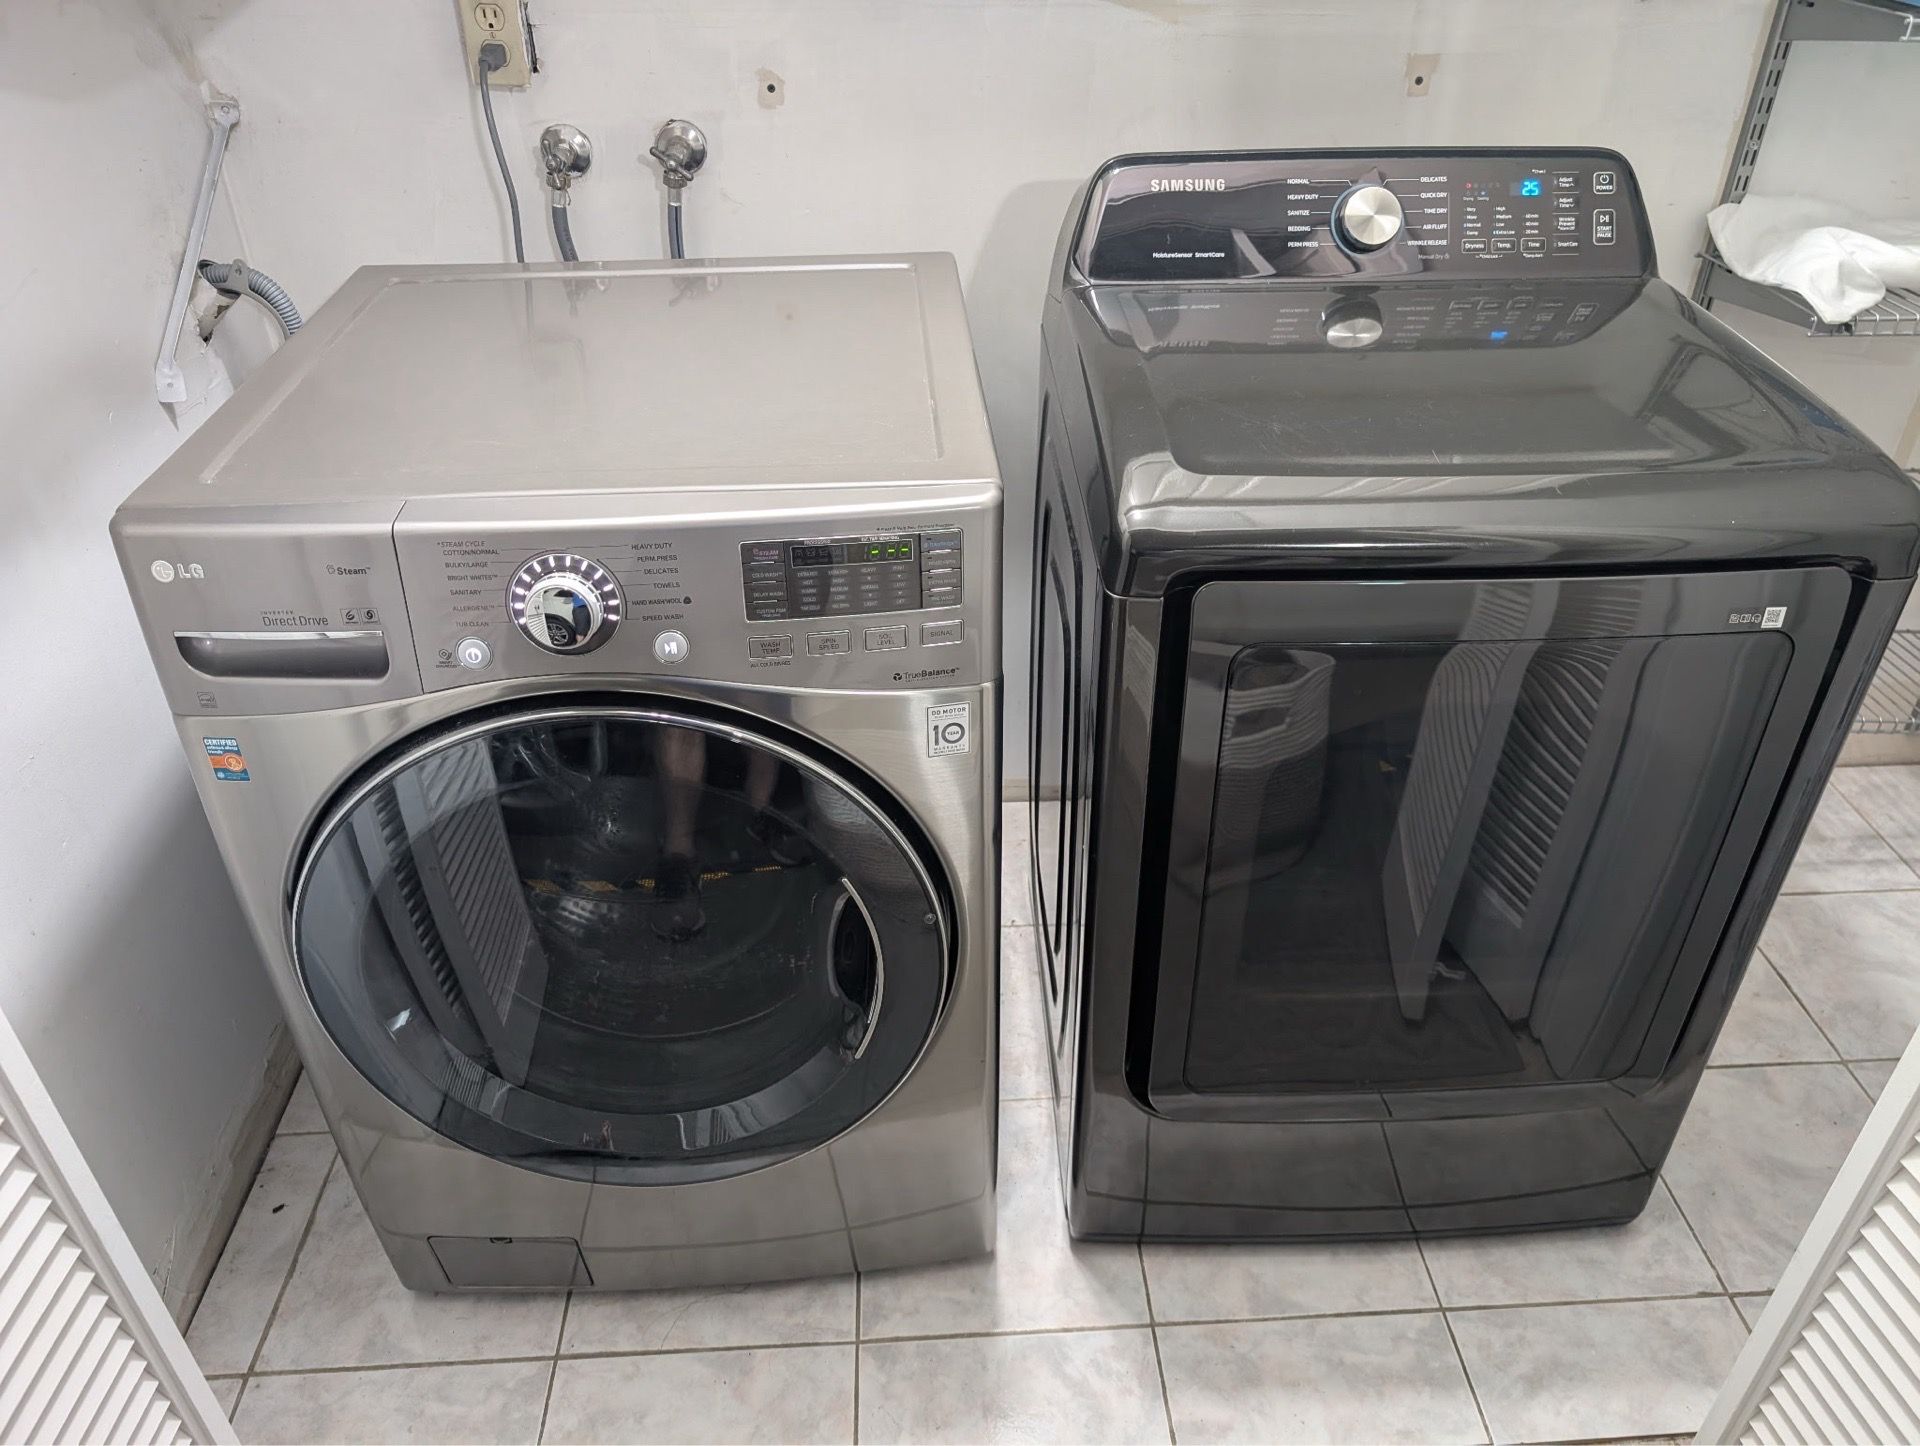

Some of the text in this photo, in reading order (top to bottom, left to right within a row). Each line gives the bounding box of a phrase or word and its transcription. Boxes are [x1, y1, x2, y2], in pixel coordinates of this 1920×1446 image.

[1151, 179, 1226, 192] SAMSUNG
[1522, 181, 1539, 196] 25
[177, 563, 204, 579] LG
[644, 567, 679, 575] DELICATES
[262, 615, 329, 627] Direct Drive
[930, 630, 953, 638] SIGNAL
[942, 707, 966, 715] MOTOR
[933, 722, 966, 746] 10
[204, 738, 238, 746] CERTIFIED
